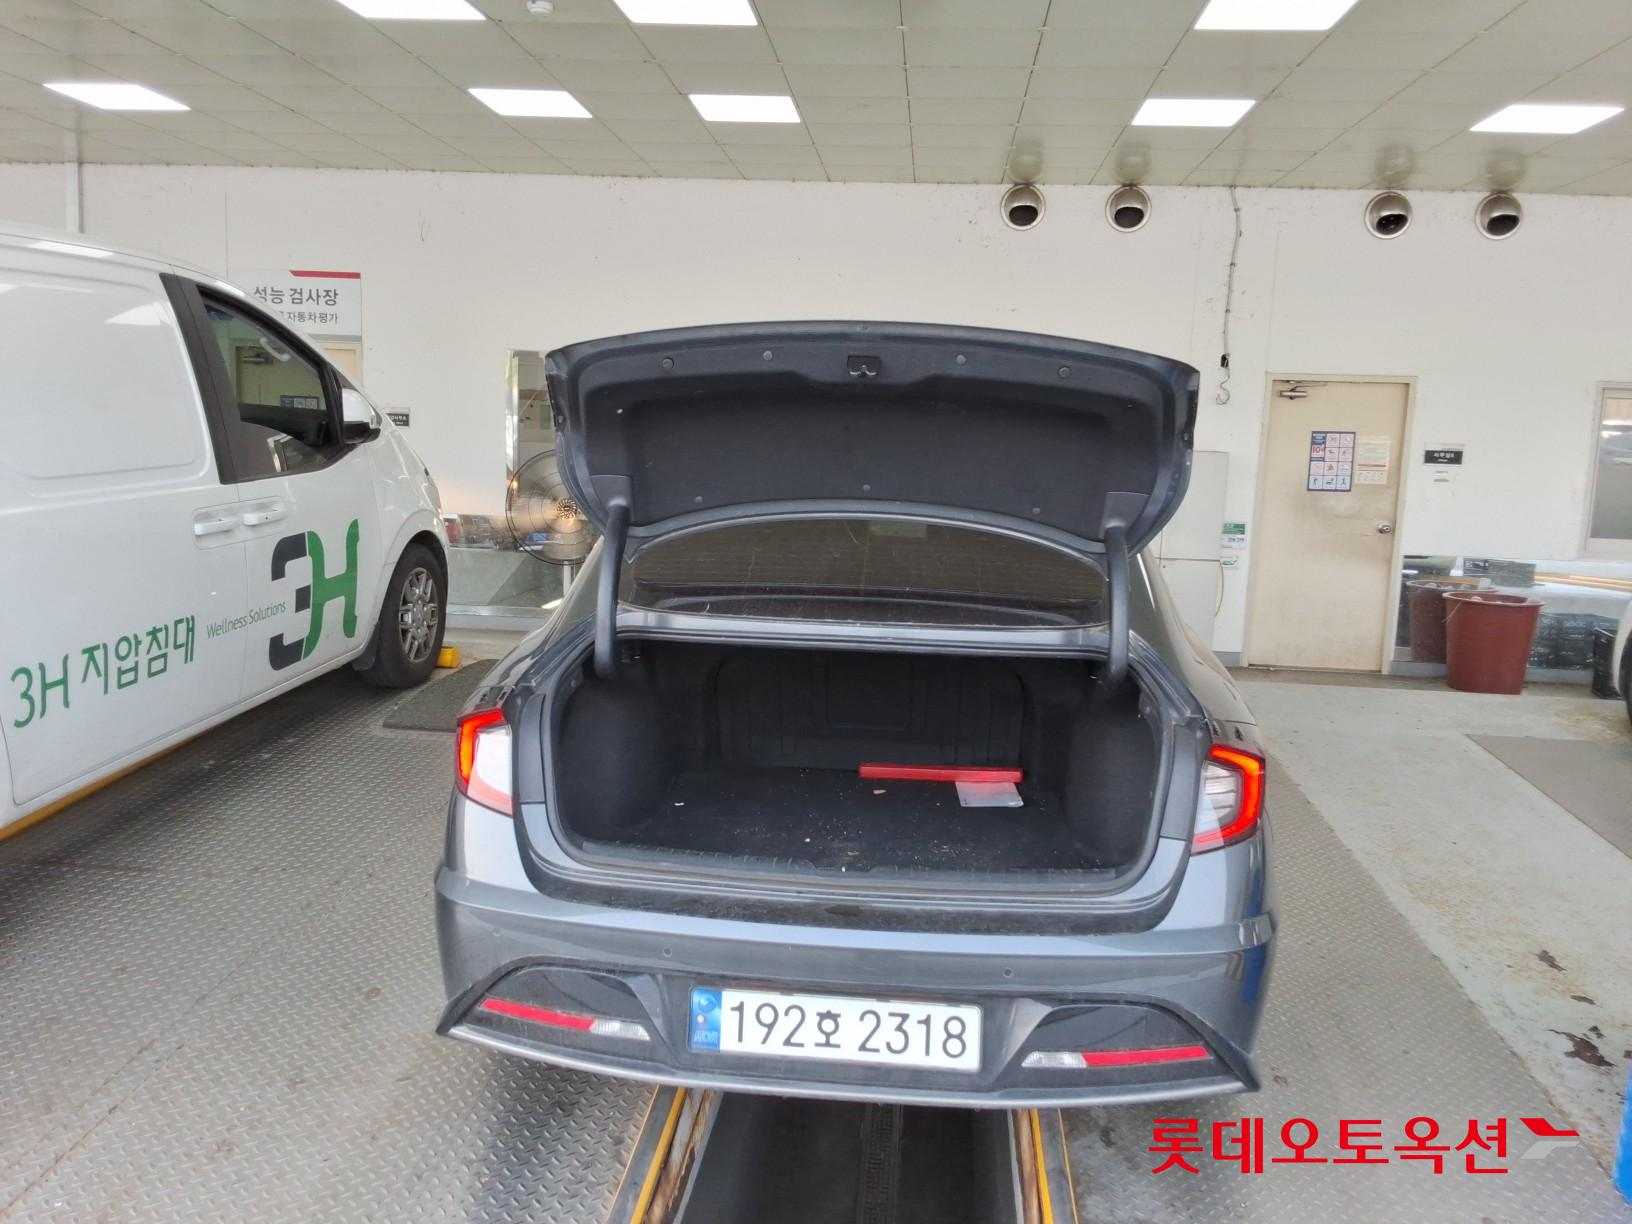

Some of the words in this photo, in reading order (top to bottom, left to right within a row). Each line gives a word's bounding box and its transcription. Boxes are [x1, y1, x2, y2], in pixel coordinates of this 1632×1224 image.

[289, 287, 339, 306] 검사장
[206, 615, 248, 639] Wellness
[248, 600, 287, 626] Solutions
[10, 653, 70, 729] 3H
[80, 615, 196, 696] 지압침대
[730, 1000, 842, 1049] 192호
[857, 1009, 967, 1058] 2318
